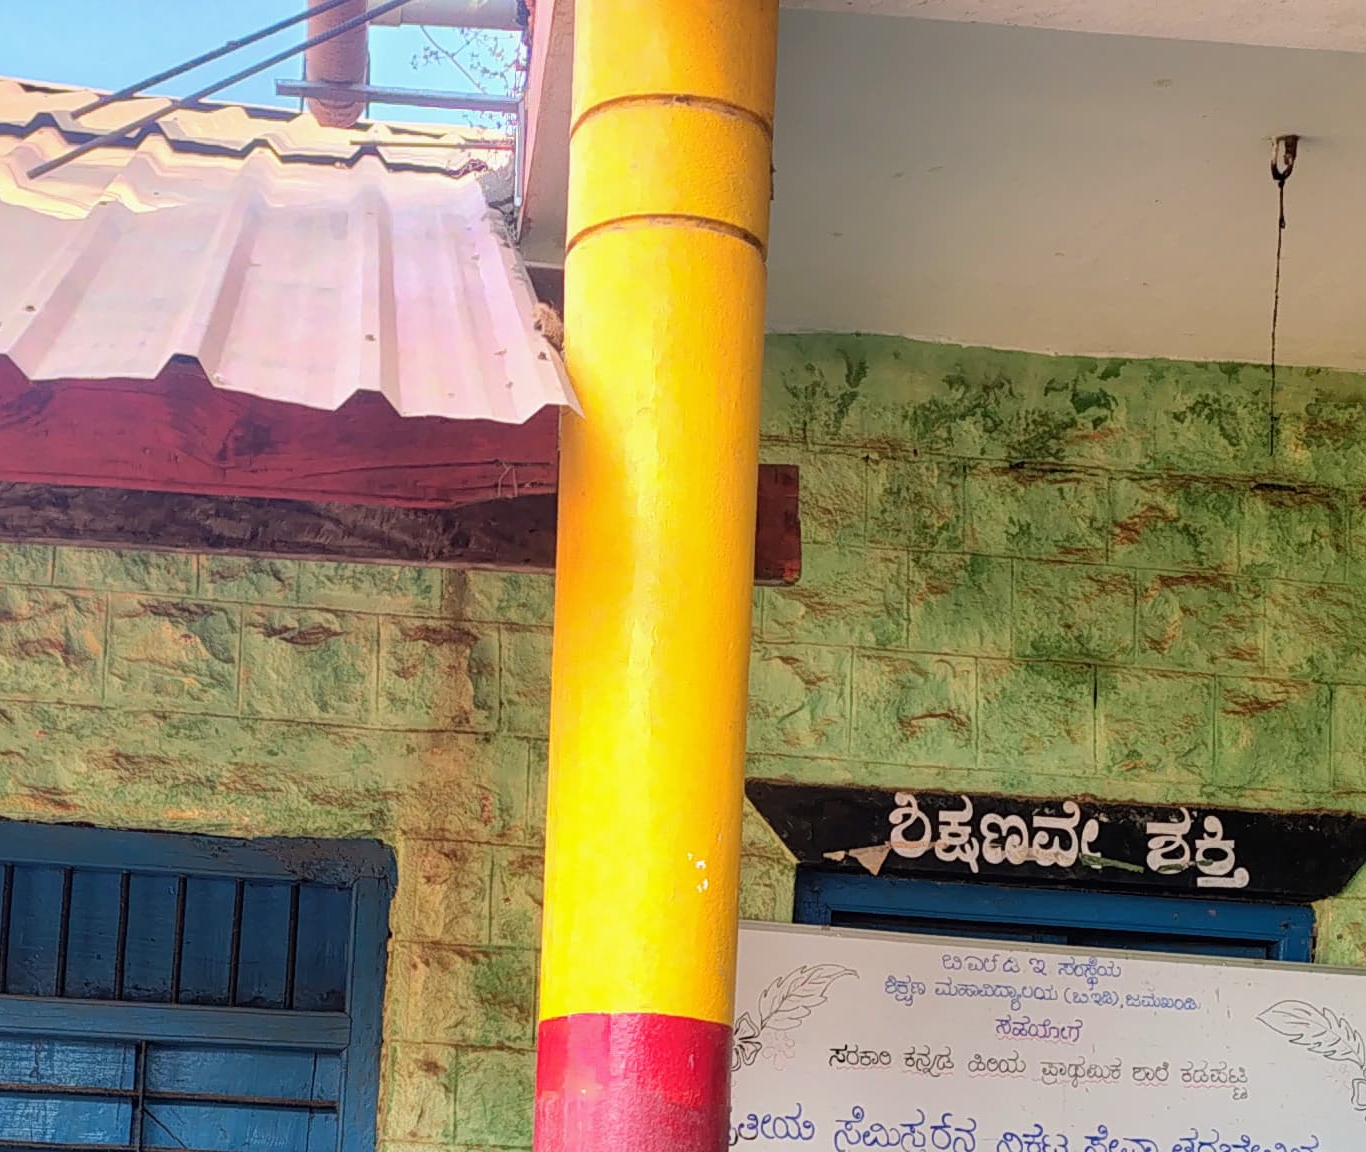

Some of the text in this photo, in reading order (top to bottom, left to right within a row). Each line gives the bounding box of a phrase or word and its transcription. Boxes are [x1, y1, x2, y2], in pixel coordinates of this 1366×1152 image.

[887, 791, 1251, 889] ಶಿಕ್ಷಣವೇ ಶಕ್ತಿ
[903, 1044, 955, 1078] ಕನ್ನಡ
[968, 1049, 1027, 1075] ಹಿರಿಯ
[1132, 1061, 1171, 1083] ಶಾಲೆ
